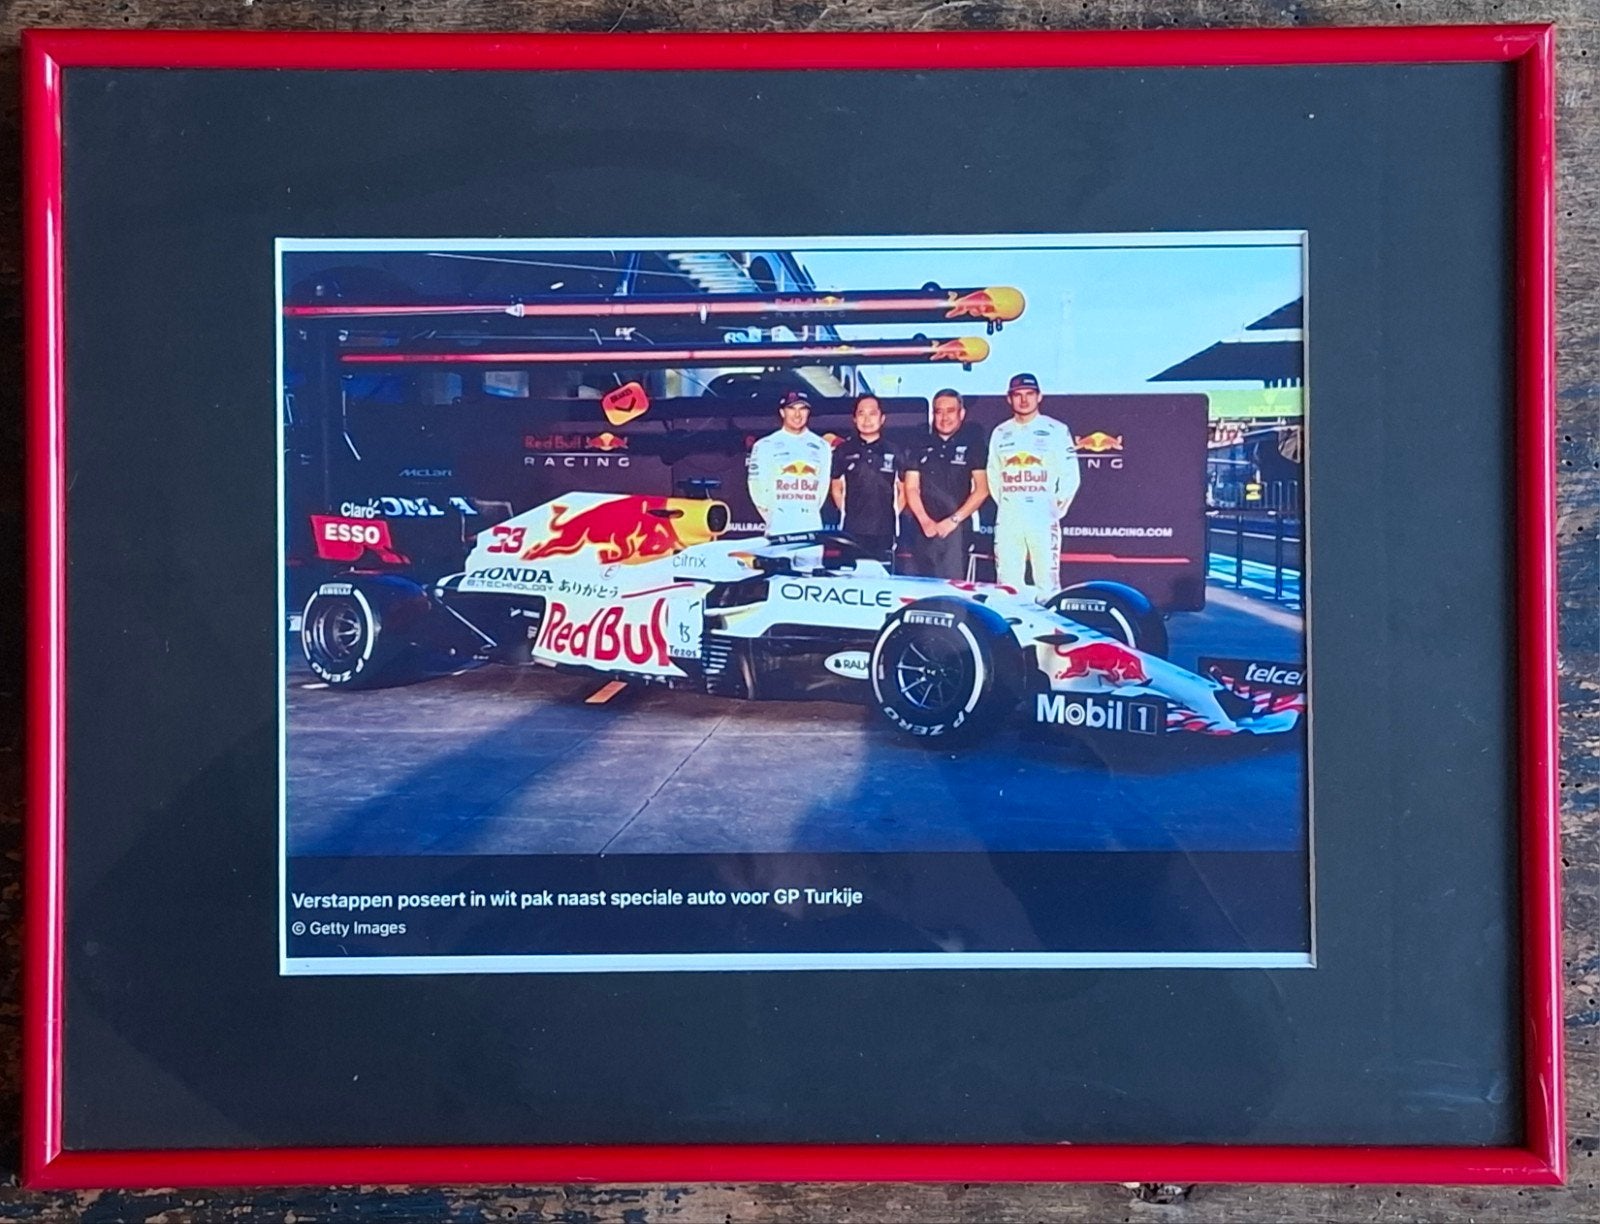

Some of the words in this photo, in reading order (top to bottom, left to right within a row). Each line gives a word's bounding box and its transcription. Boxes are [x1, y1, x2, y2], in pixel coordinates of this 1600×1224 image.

[524, 435, 553, 449] Red
[524, 456, 630, 467] RACING
[776, 480, 799, 491] Red
[1024, 470, 1048, 483] Bull
[340, 501, 376, 519] Claro
[324, 523, 380, 545] ESSO
[1062, 526, 1173, 537] REDBULLRACING.COM
[558, 579, 618, 598] ありがとう
[781, 583, 892, 607] ORACLE
[903, 609, 955, 629] PIRELLI
[669, 645, 697, 657] Tezos
[952, 710, 965, 728] P
[1036, 693, 1123, 730] Mobil
[883, 706, 945, 736] ZERO
[291, 892, 393, 911] Verstappen
[397, 891, 466, 910] poseert
[470, 890, 486, 907] in
[490, 890, 517, 906] wit
[520, 890, 553, 909] pak
[557, 890, 606, 906] naast
[610, 888, 683, 909] speciale
[687, 890, 726, 905] auto
[731, 890, 770, 905] voor
[773, 888, 800, 904] GP
[804, 887, 863, 907] Turkije
[309, 920, 350, 938] Getty
[353, 920, 407, 937] Images
